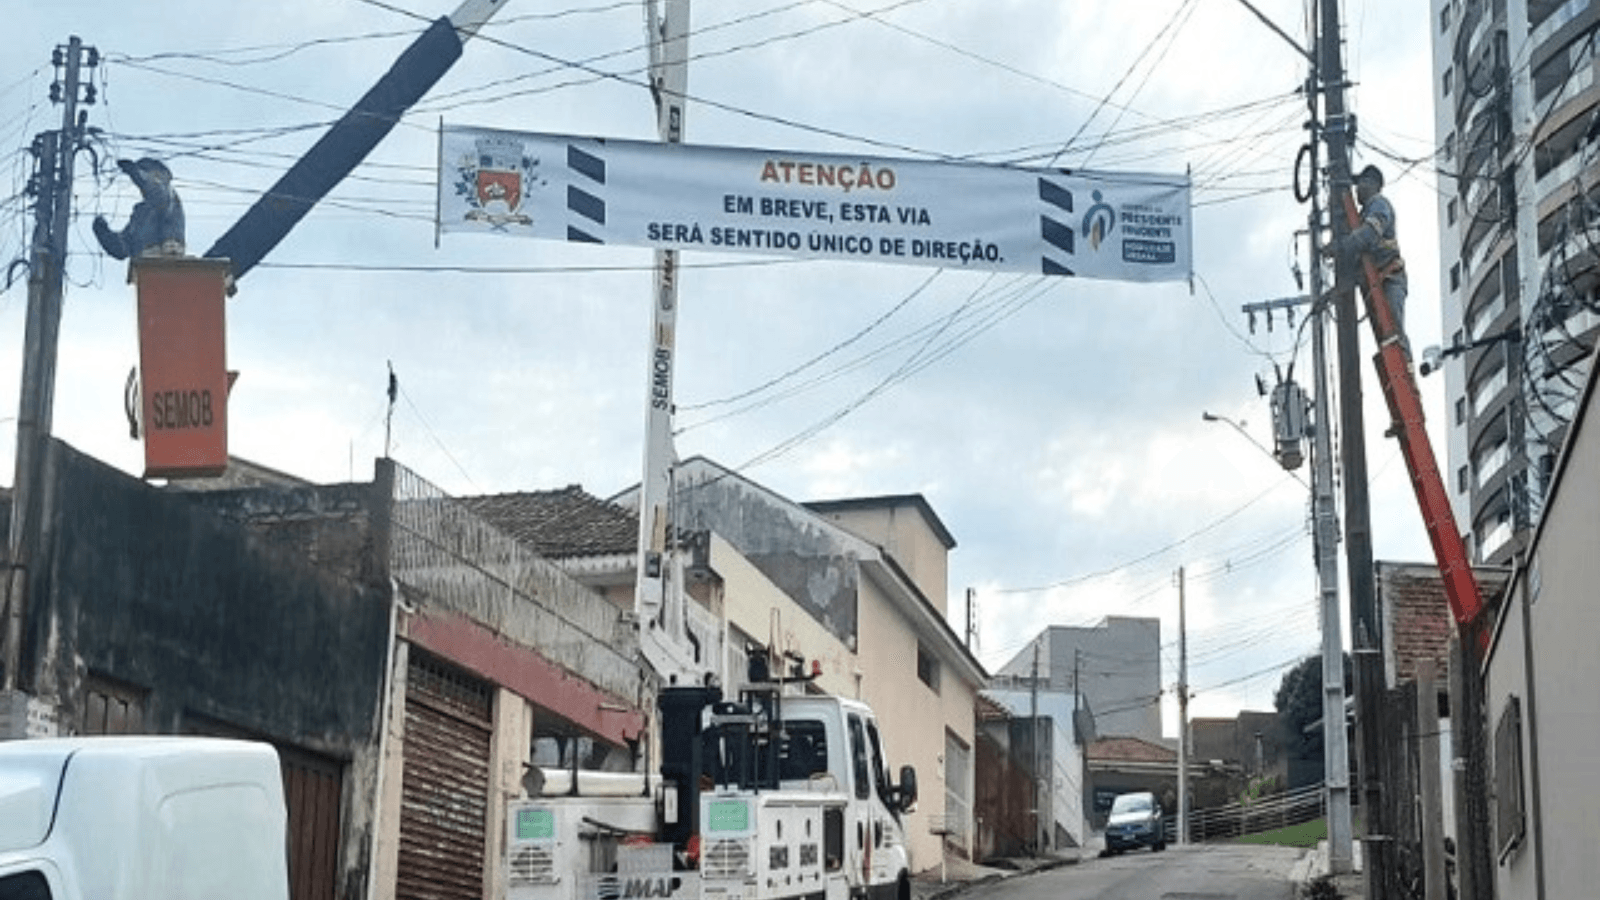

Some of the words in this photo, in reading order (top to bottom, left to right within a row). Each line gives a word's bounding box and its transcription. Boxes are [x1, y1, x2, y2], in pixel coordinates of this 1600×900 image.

[761, 161, 896, 192] ATENÇÃO
[723, 195, 753, 215] EM
[760, 197, 833, 223] BREVE,
[840, 202, 891, 223] ESTA
[897, 207, 931, 225] VIA
[647, 222, 703, 244] SERÁ
[710, 227, 800, 250] SENTIDO
[808, 231, 873, 254] ÚNICO
[879, 238, 905, 256] DE
[912, 239, 1004, 264] DIREÇÃO.
[652, 348, 670, 410] SEMOB
[152, 389, 213, 429] SEMOB
